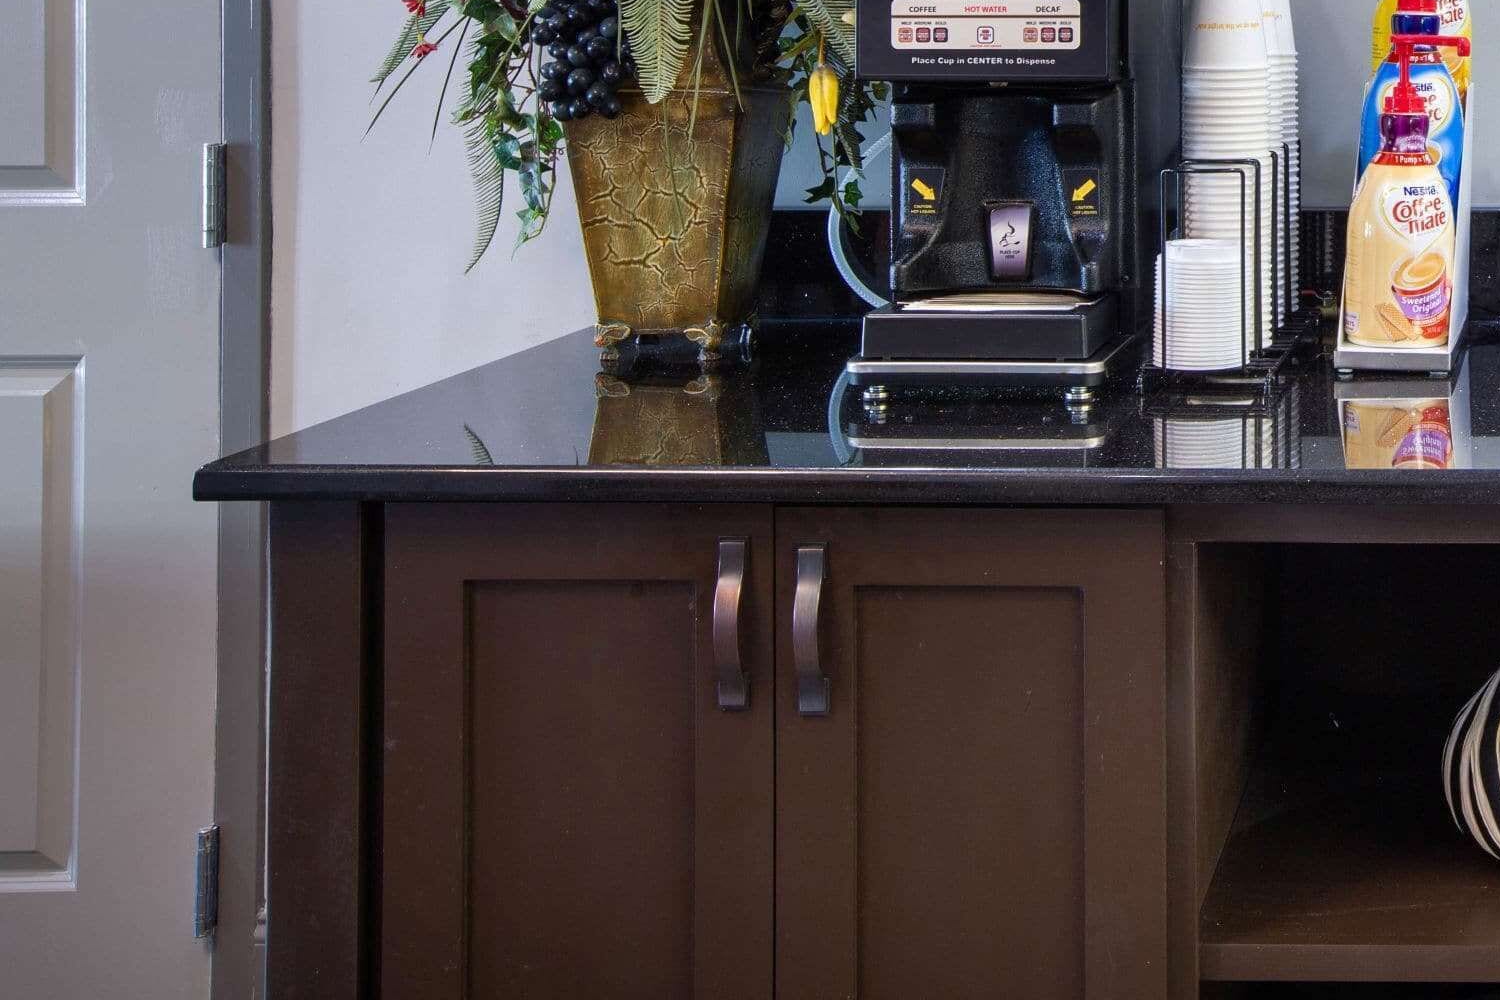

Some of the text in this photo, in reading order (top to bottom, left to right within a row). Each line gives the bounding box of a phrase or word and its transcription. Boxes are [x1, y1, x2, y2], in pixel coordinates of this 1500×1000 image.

[908, 5, 937, 13] COFFEE
[964, 5, 1008, 13] HOT WATER
[1035, 5, 1061, 13] DECAF
[911, 57, 1056, 66] Place Cup in CENTER to Dispense
[1400, 155, 1418, 164] Pump
[1408, 211, 1446, 234] mate
